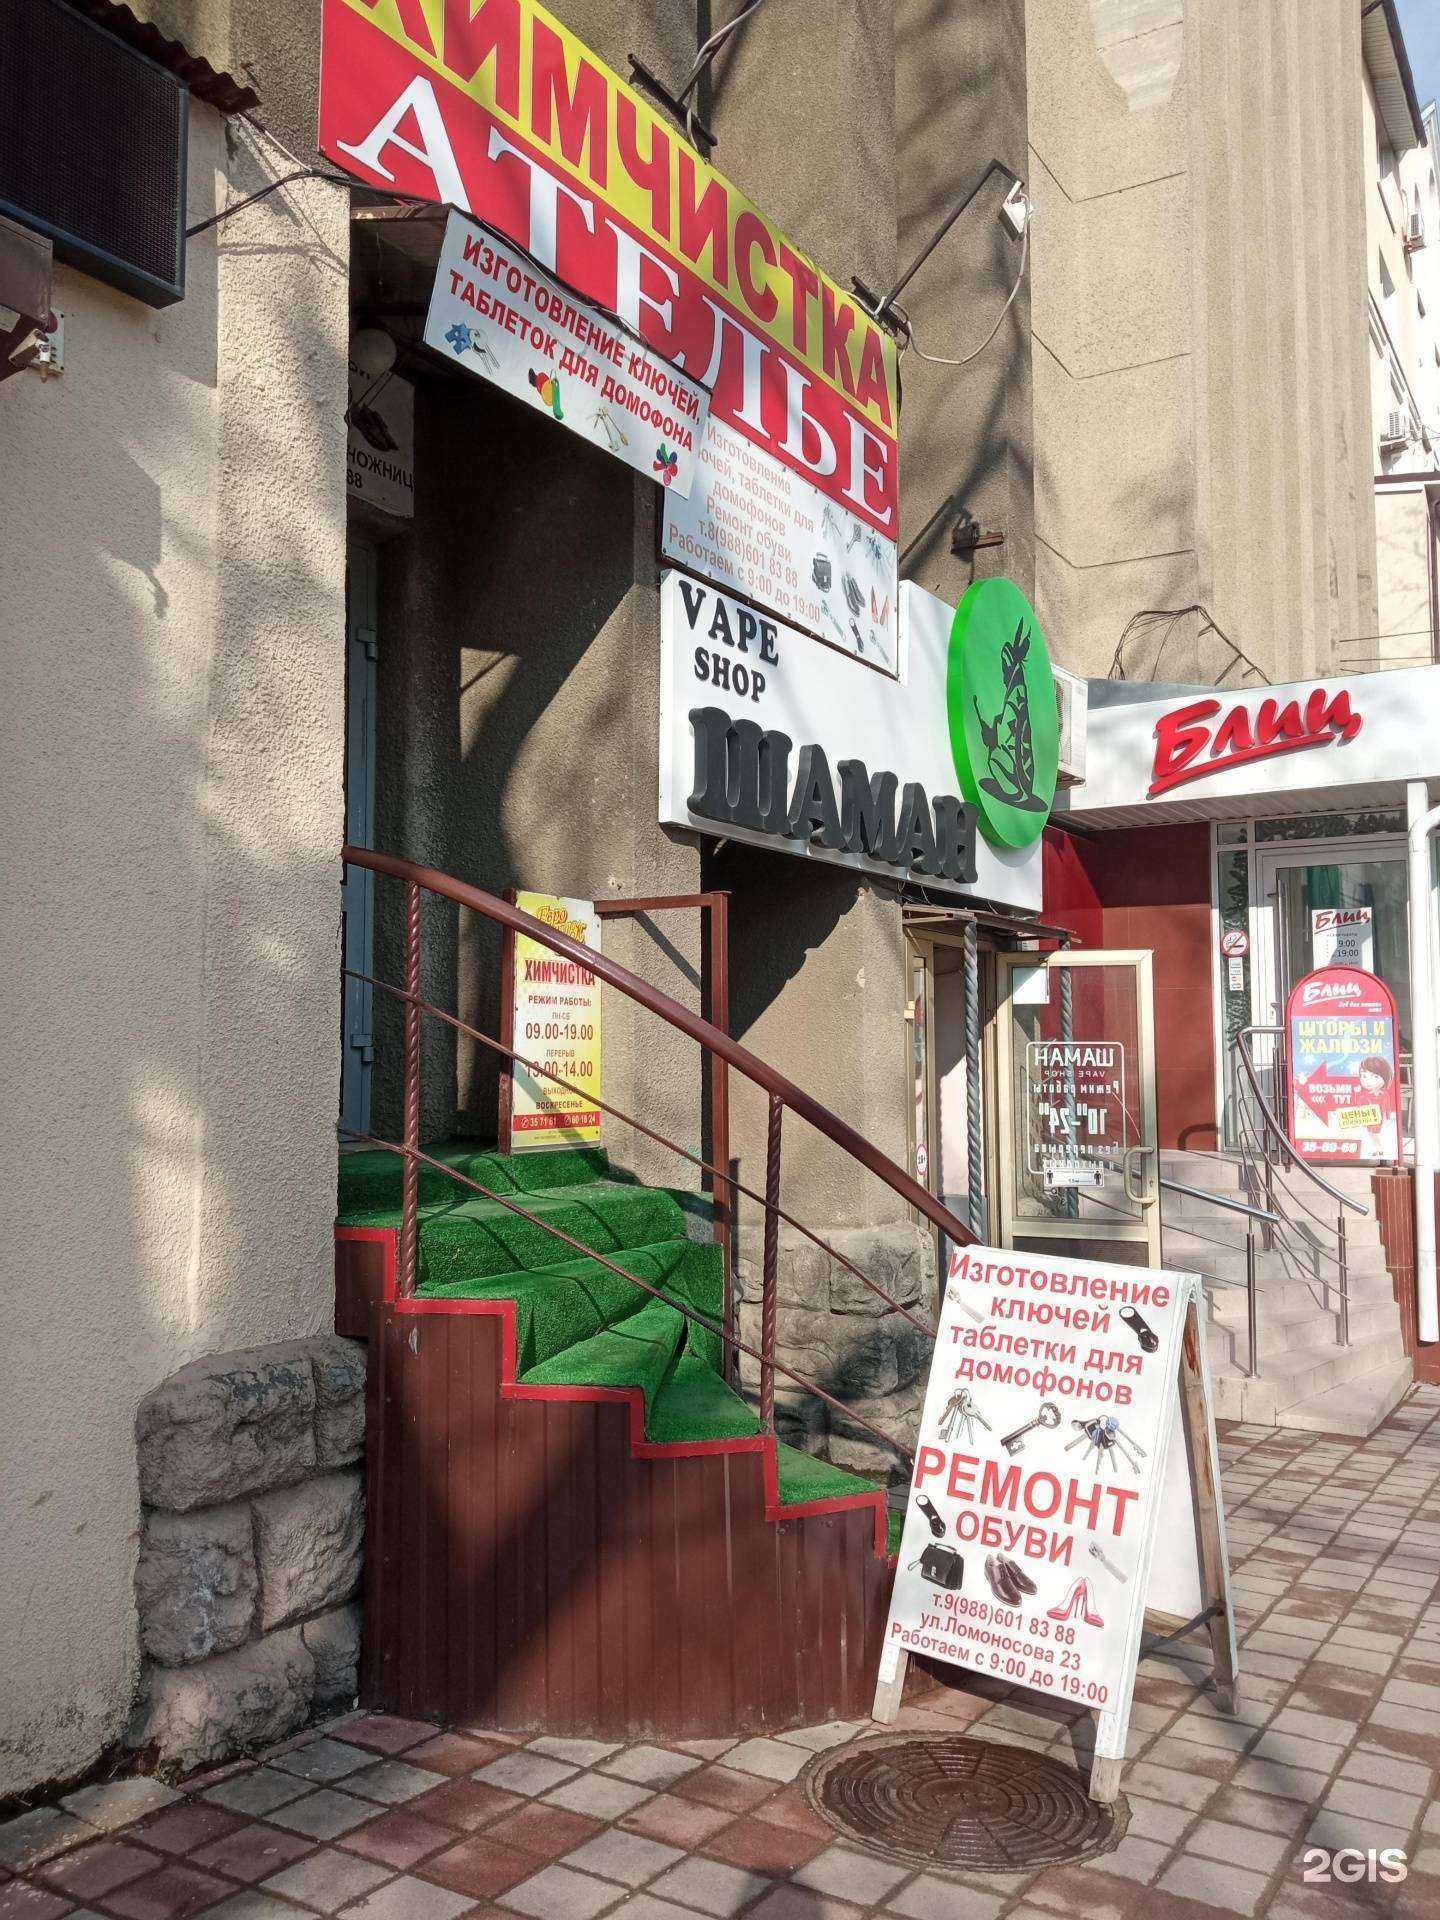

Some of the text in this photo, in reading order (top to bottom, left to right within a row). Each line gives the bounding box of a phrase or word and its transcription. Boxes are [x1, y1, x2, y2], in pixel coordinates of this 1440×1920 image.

[336, 74, 892, 527] АТЕЛЬЕ
[462, 234, 701, 425] ИЗГОТОВЛЕНИЕ КЛЮЧЕЙ,
[450, 269, 693, 452] ТАБЛЕТОК ДЛЯ ДОМОФОНА
[707, 425, 791, 495] Изготовление
[698, 447, 815, 534] ючей, таблетки для
[713, 480, 786, 538] домофонов
[706, 496, 792, 565] Ремонт обуви
[669, 523, 820, 624] Работаем с 9:00 до 19:00
[769, 557, 783, 578] 83
[678, 579, 779, 667] VAPE
[693, 646, 767, 703] SHOP
[687, 706, 980, 884] ШАМАН
[525, 959, 595, 986] ХИМЧИСТКА
[1337, 949, 1359, 958] 19:00
[528, 995, 558, 1005] РЕЖИМ
[1298, 1020, 1385, 1036] ШТОРЫ И
[525, 1022, 594, 1041] 09.00-19.00
[1299, 1038, 1383, 1054] ЖАЛЮЗИ
[535, 1100, 583, 1110] ВОСКРЕСЕНЬЕ
[949, 1254, 1170, 1308] Изготовление
[990, 1296, 1111, 1334] ключей
[951, 1325, 1144, 1376] таблетки для
[955, 1357, 1132, 1405] домофонов
[914, 1446, 1139, 1536] РЕМОНТ
[955, 1510, 1074, 1567] ОБУВИ
[919, 1610, 1081, 1671] ул.Ломоносова 23
[932, 1593, 1075, 1645] т.9(988)601 83 88
[891, 1622, 1109, 1703] Работаем с 9:00 до 19:00
